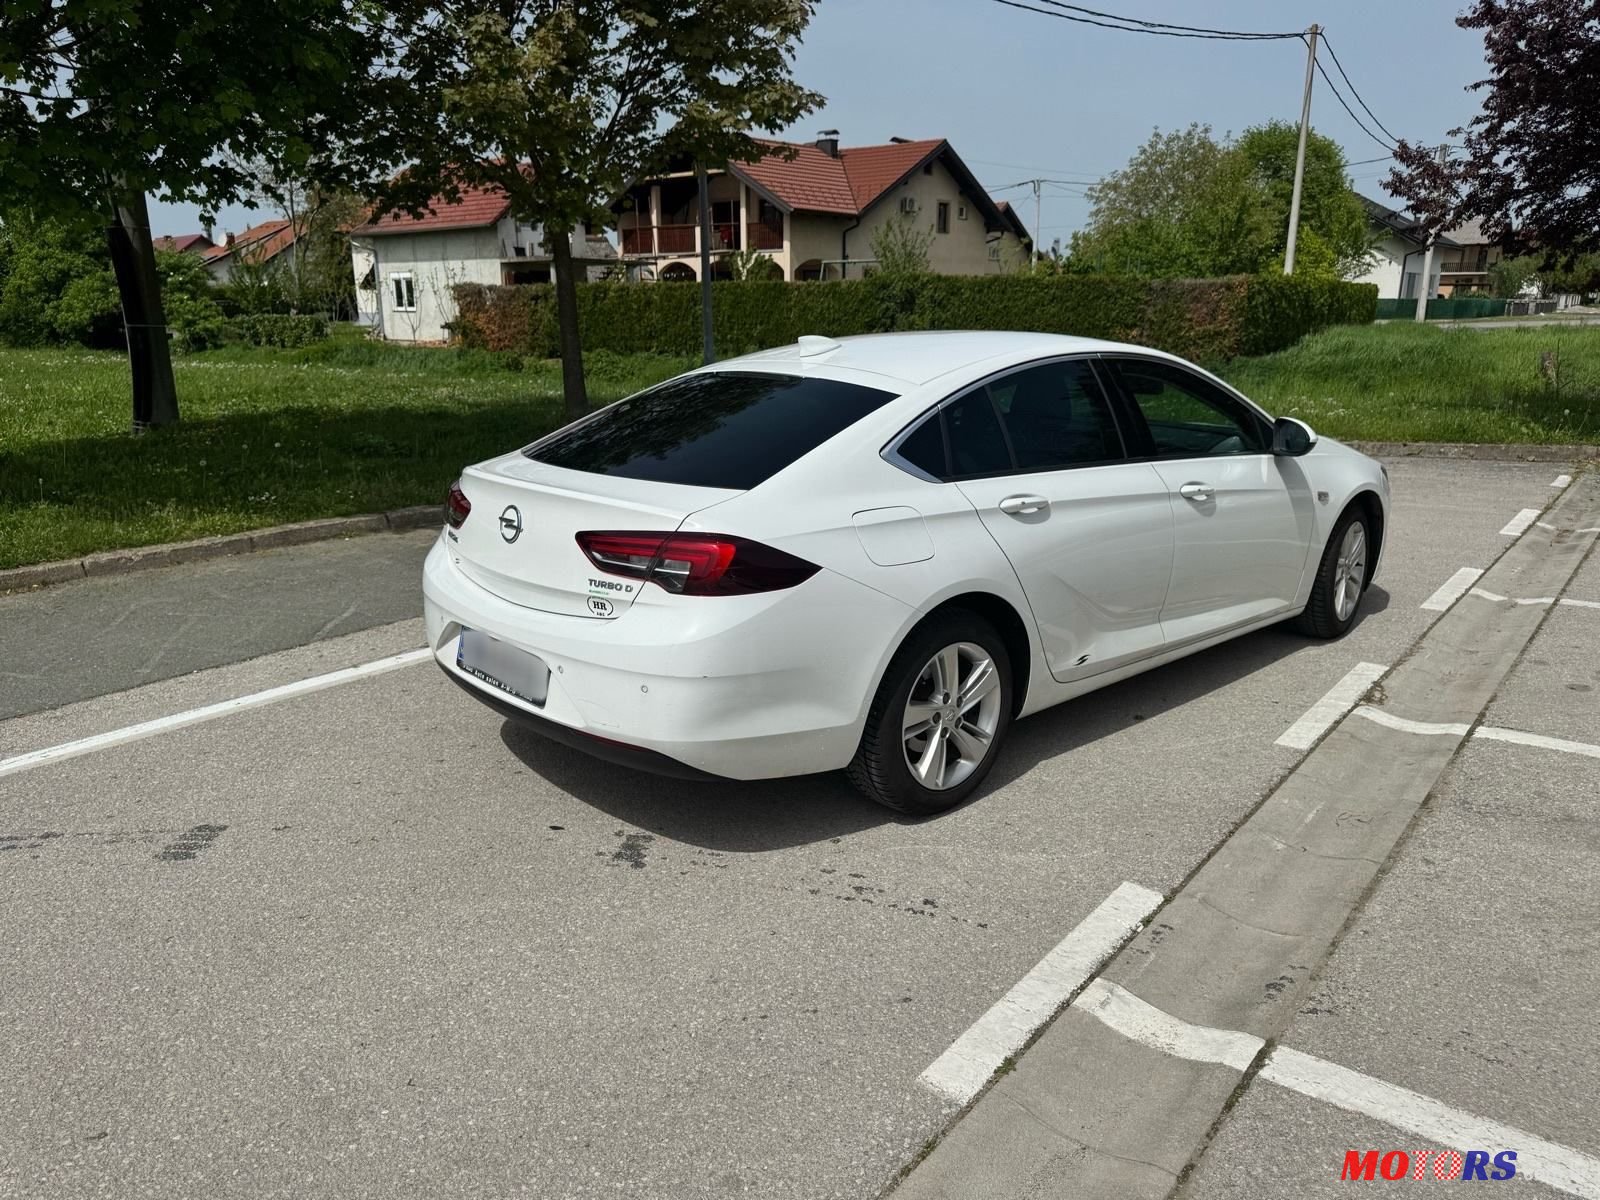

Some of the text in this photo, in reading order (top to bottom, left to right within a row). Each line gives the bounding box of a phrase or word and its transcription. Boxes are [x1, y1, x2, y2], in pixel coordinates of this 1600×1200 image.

[588, 578, 633, 593] TURBO D
[592, 600, 607, 611] HR
